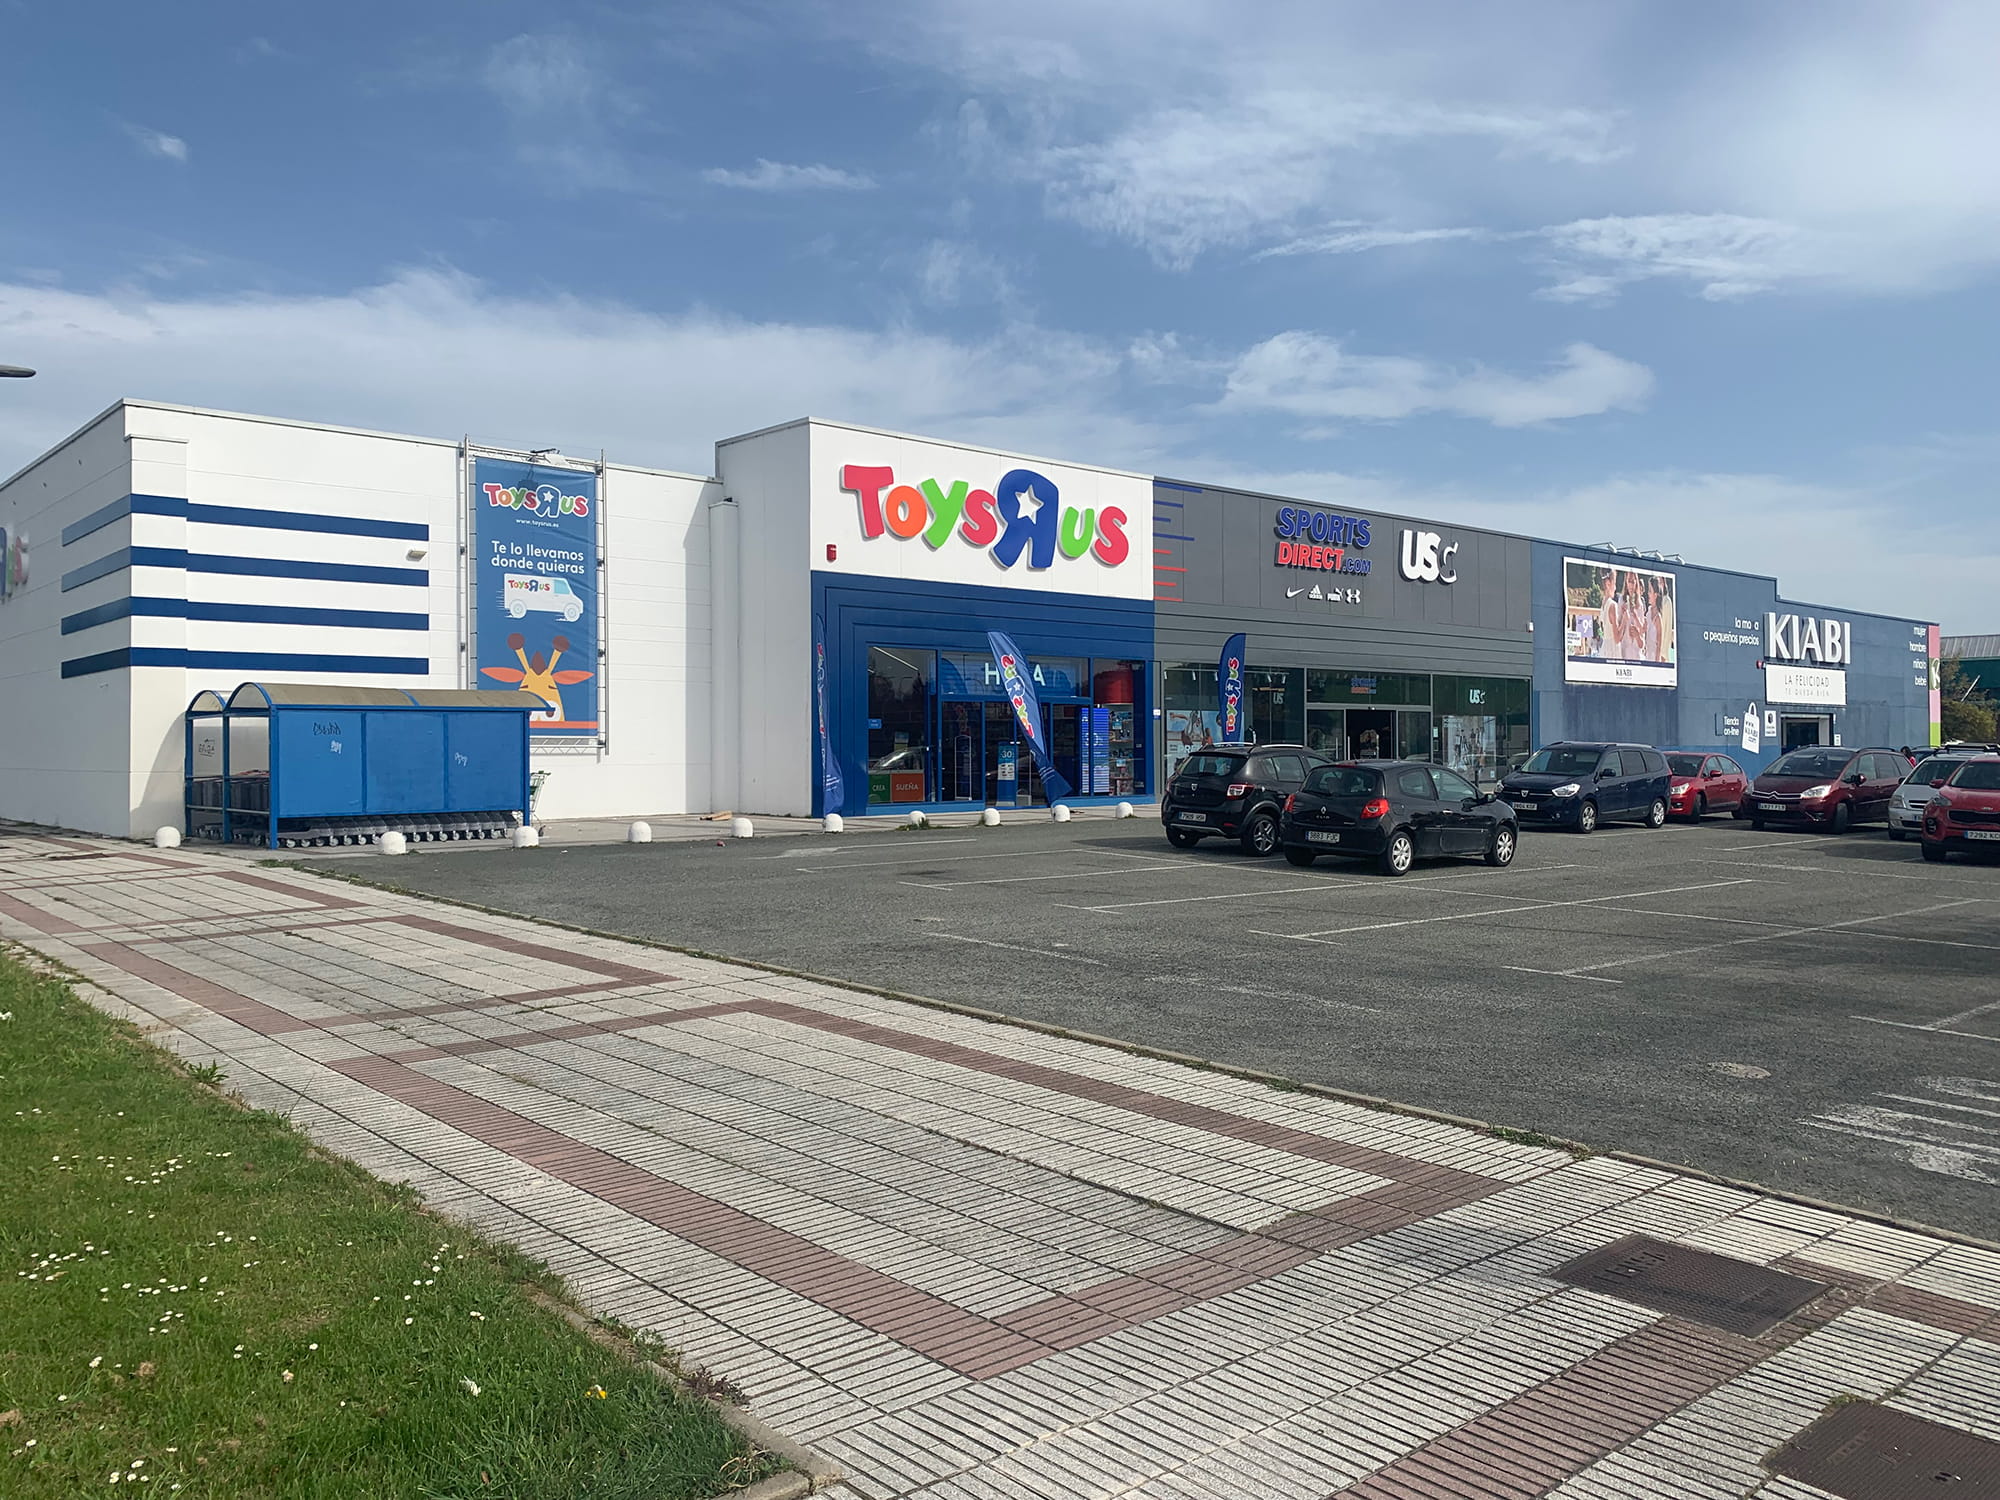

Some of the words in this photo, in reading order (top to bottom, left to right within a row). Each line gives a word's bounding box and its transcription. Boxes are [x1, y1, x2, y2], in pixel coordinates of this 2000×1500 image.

[1277, 506, 1371, 547] SPORTS
[491, 540, 506, 554] Te
[510, 542, 523, 555] lo
[526, 543, 584, 561] llevamos
[491, 555, 534, 570] donde
[537, 560, 585, 574] quieras
[1703, 631, 1709, 640] a
[1710, 631, 1738, 644] pequeños
[1739, 634, 1759, 645] precios
[1766, 612, 1850, 664] KIABI
[1784, 675, 1793, 685] LA
[1796, 674, 1830, 687] FELICIDAD
[1723, 715, 1740, 726] Tienda
[1723, 727, 1740, 736] on-line
